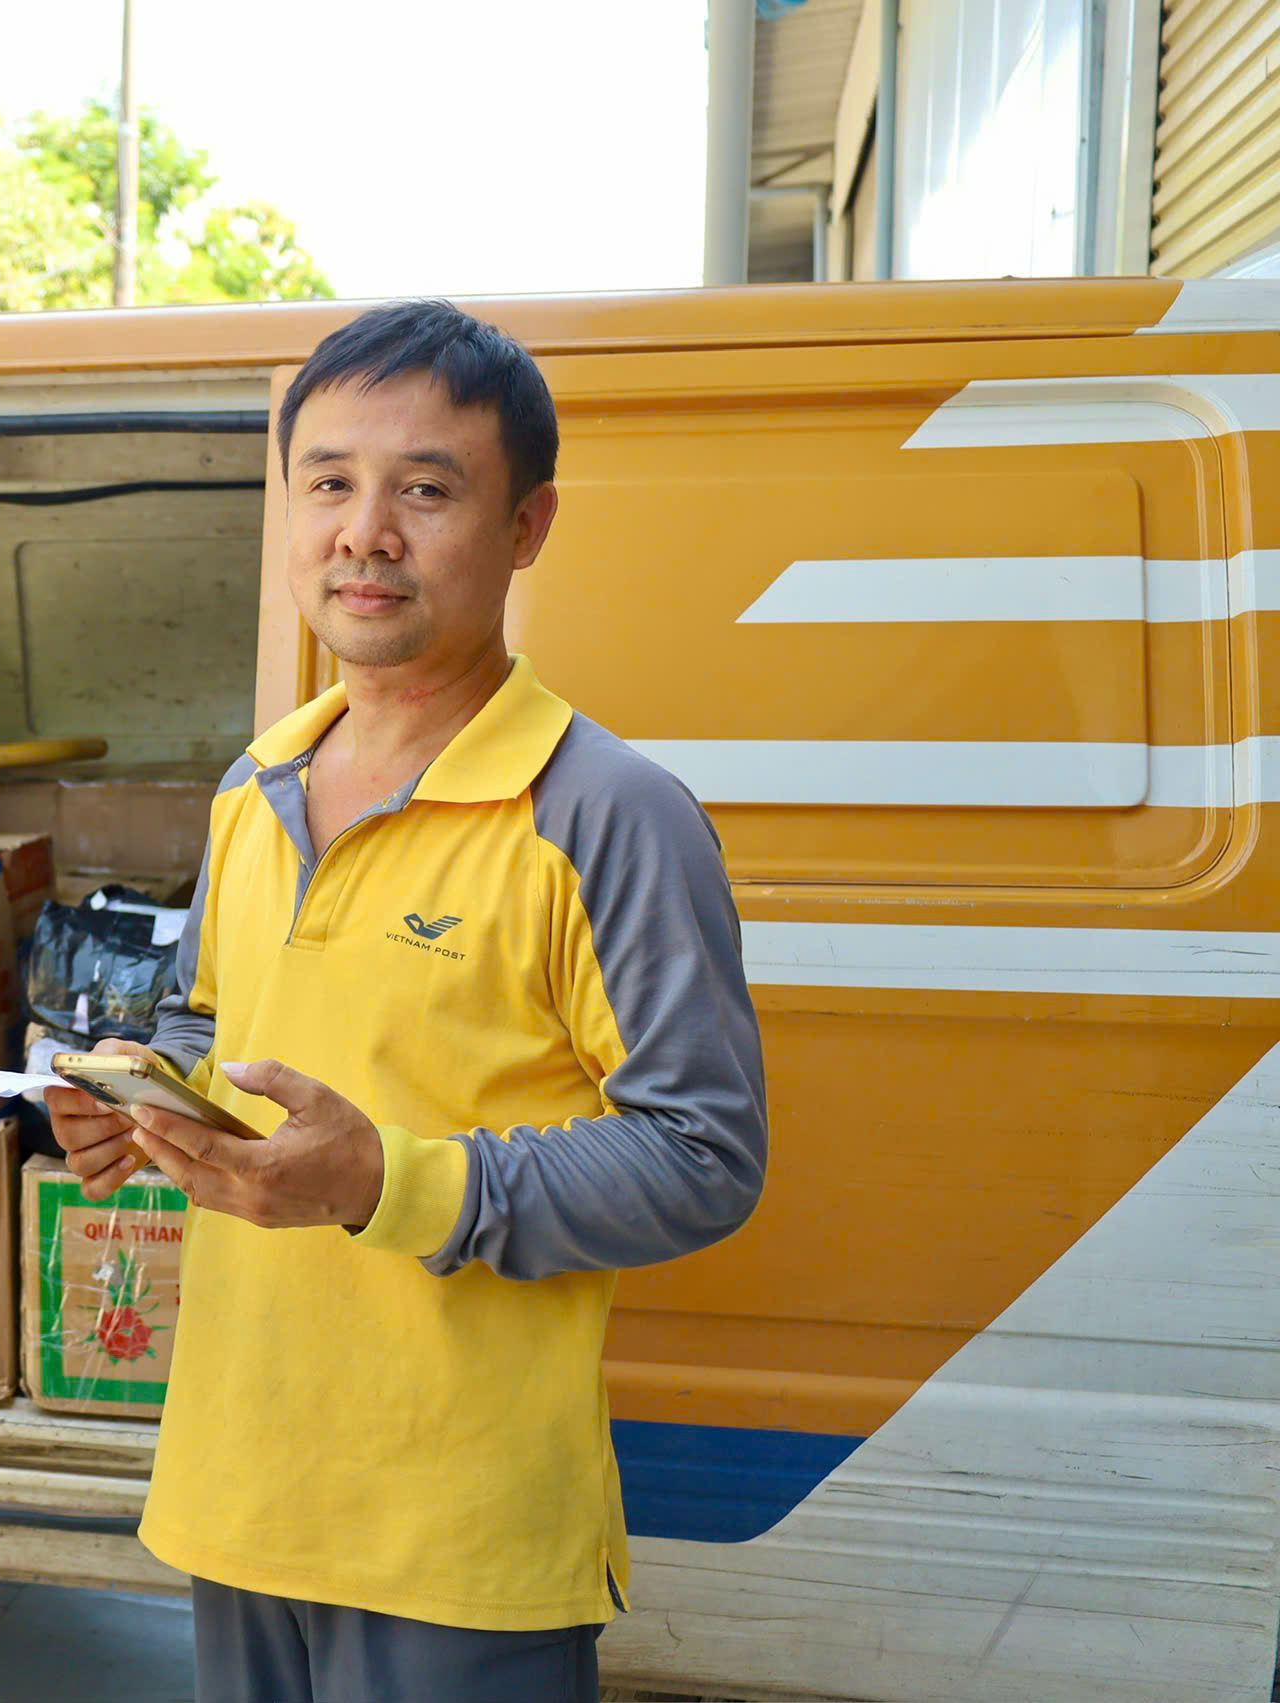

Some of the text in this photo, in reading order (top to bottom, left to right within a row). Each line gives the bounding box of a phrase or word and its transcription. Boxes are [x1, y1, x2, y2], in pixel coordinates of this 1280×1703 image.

[386, 931, 466, 960] VIETNAM POST
[130, 1224, 183, 1243] THAN
